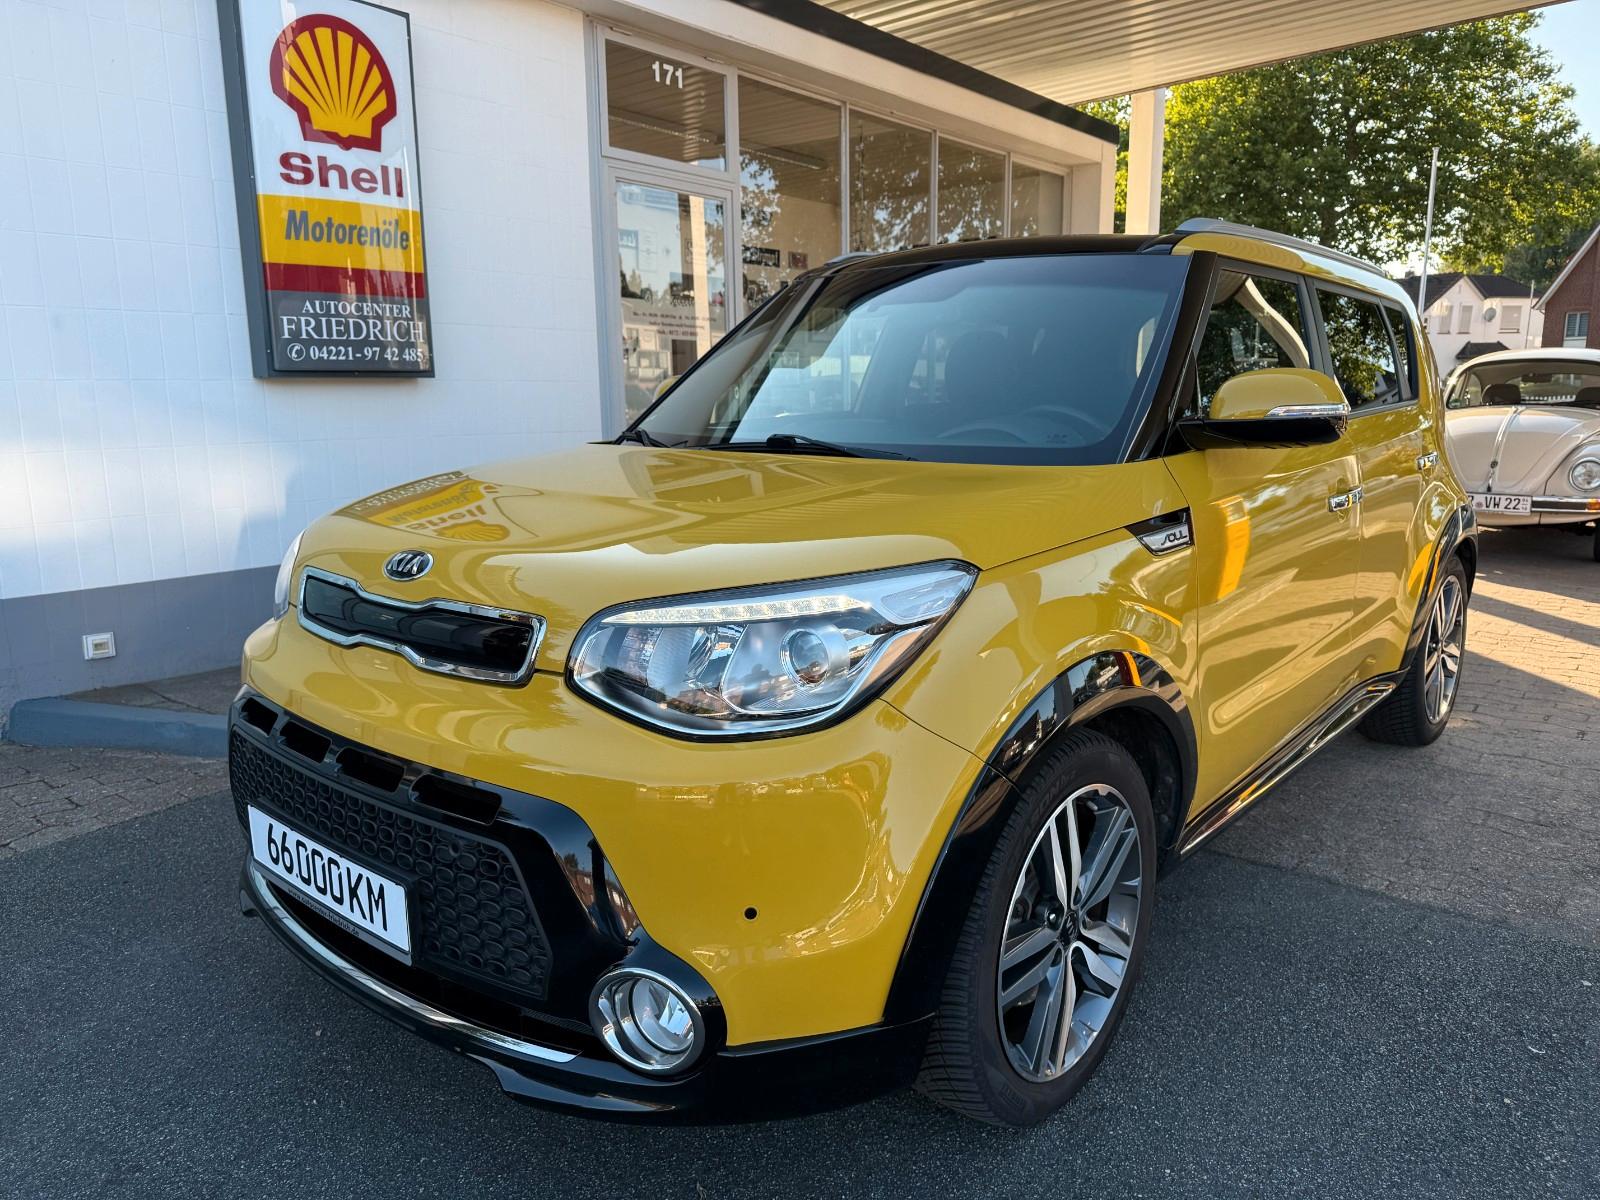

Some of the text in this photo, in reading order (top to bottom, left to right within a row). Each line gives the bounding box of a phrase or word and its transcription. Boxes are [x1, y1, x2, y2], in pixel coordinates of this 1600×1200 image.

[652, 61, 683, 89] 171
[279, 152, 405, 198] Shell
[285, 209, 410, 250] Motorenöle
[302, 300, 412, 319] AUTOCENTER
[280, 316, 425, 343] FRIEDRICH
[384, 347, 400, 362] 42
[403, 347, 424, 363] 485
[1485, 495, 1502, 509] VW
[1503, 497, 1521, 511] 22
